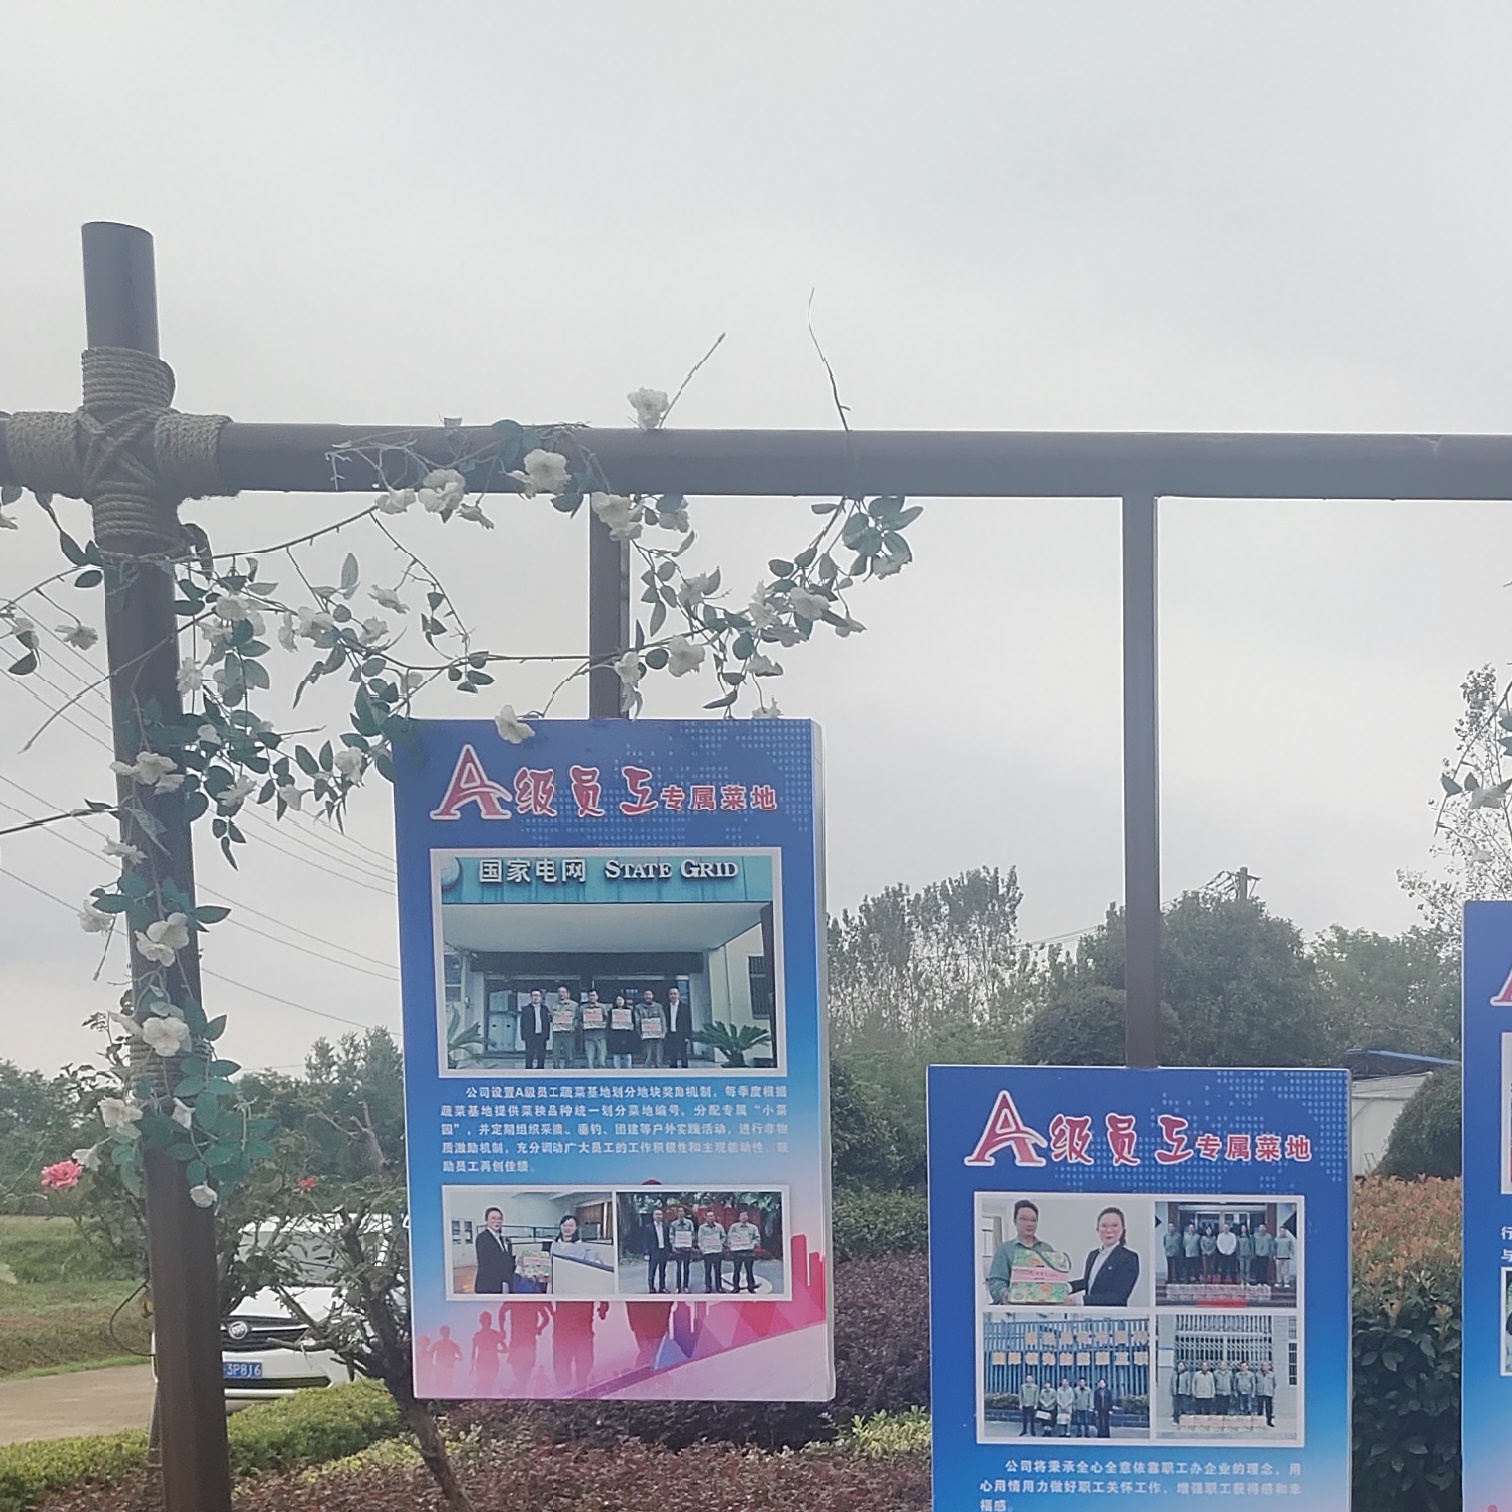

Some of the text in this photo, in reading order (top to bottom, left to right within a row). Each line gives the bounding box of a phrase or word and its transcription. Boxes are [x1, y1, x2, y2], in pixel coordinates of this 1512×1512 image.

[429, 744, 778, 820] A级员工专属菜地
[478, 859, 738, 883] 国家电网 STATE GRID
[964, 1089, 1313, 1168] A级员工专属菜地
